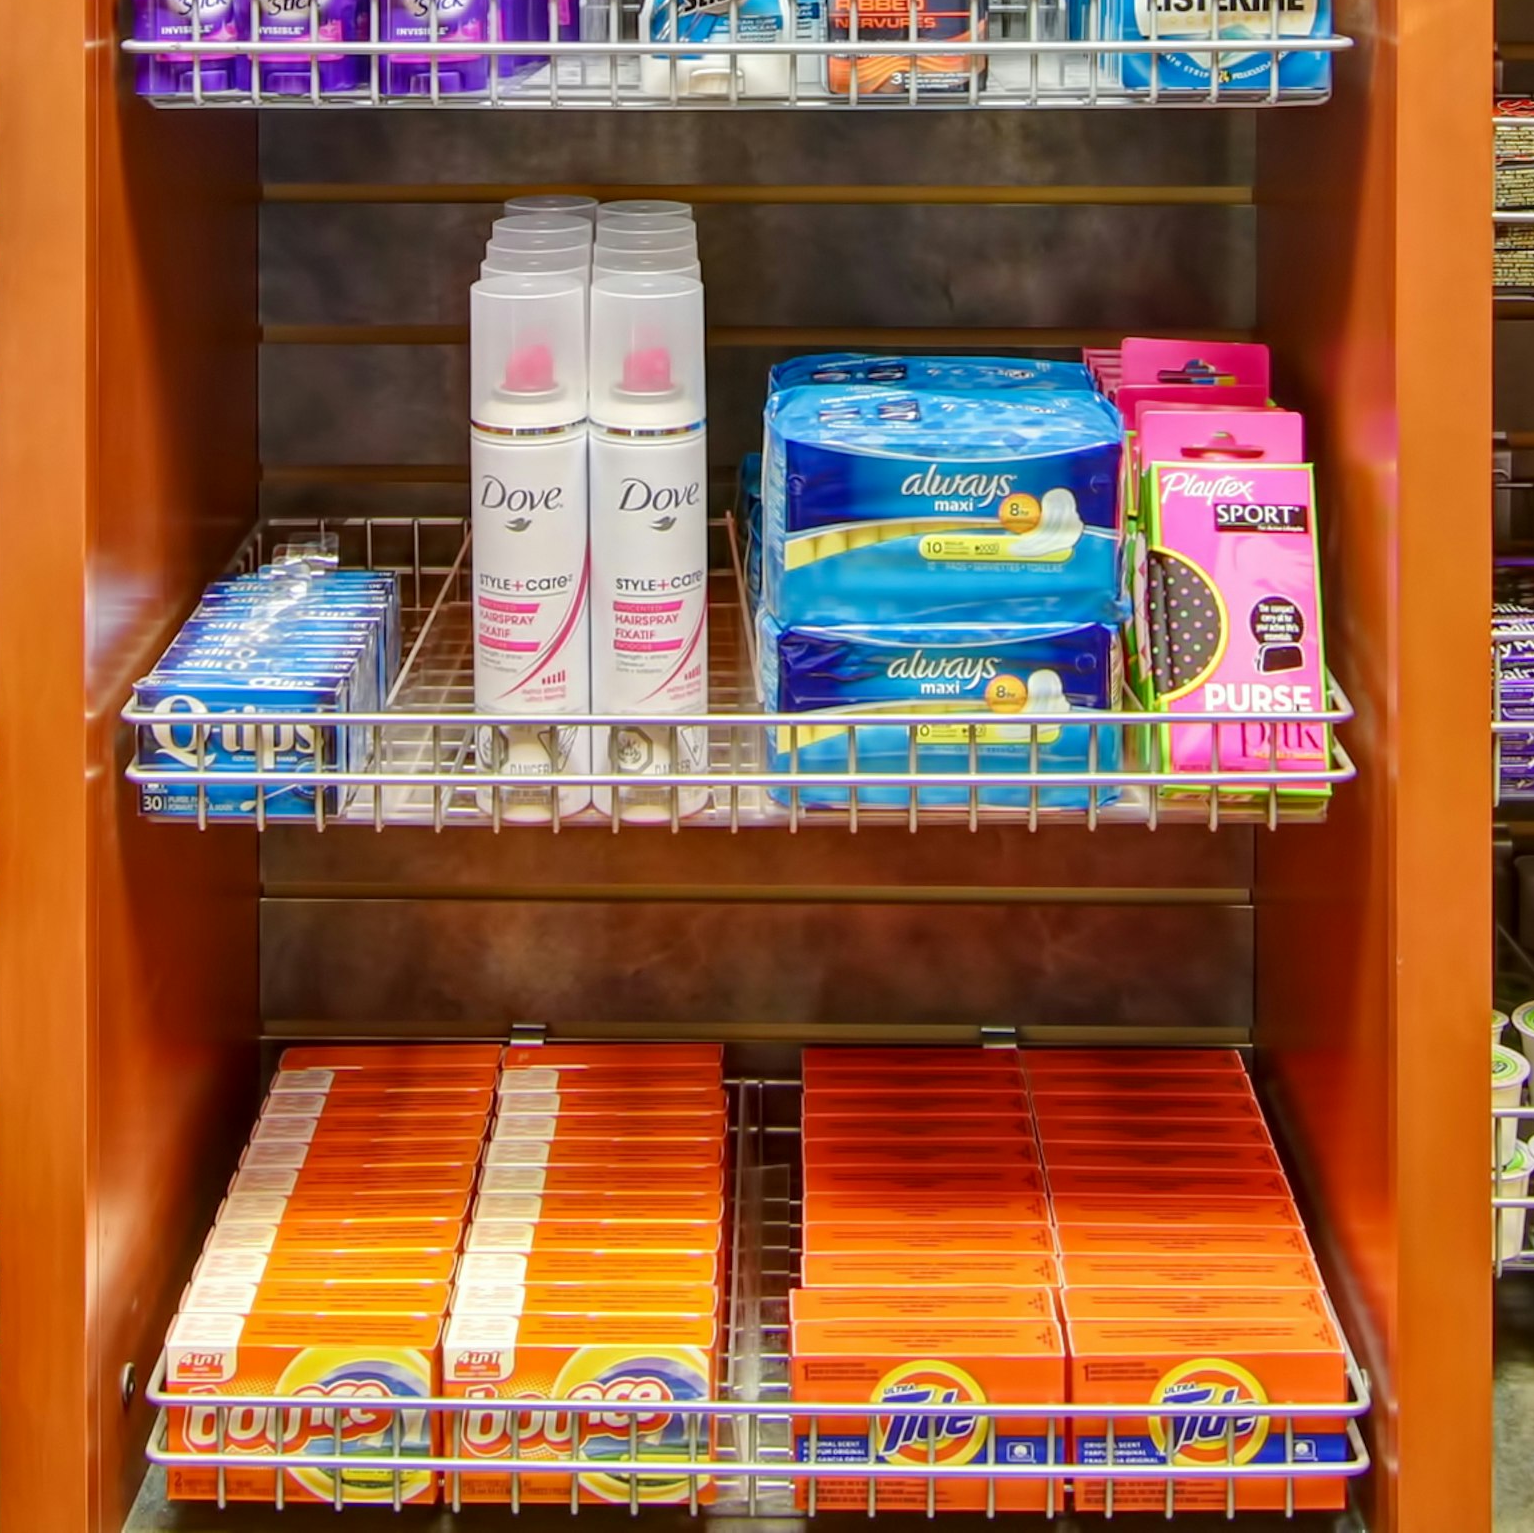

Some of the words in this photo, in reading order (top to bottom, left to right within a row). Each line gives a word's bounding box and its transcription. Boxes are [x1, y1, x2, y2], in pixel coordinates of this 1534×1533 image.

[480, 474, 563, 513] Dove
[901, 464, 1016, 509] always
[1160, 471, 1256, 506] Playtex
[618, 476, 701, 513] Dove
[934, 498, 975, 513] maxi
[1216, 504, 1293, 525] SPORT
[926, 542, 943, 555] 10
[615, 612, 680, 626] HAIRSPRAY
[615, 627, 657, 640] FIXATIF
[886, 649, 1002, 691] always
[920, 680, 961, 695] maxi
[1204, 682, 1314, 712] PURSE
[143, 796, 163, 811] 30
[883, 1384, 916, 1396] ULTRA
[1164, 1383, 1197, 1395] ULTRA
